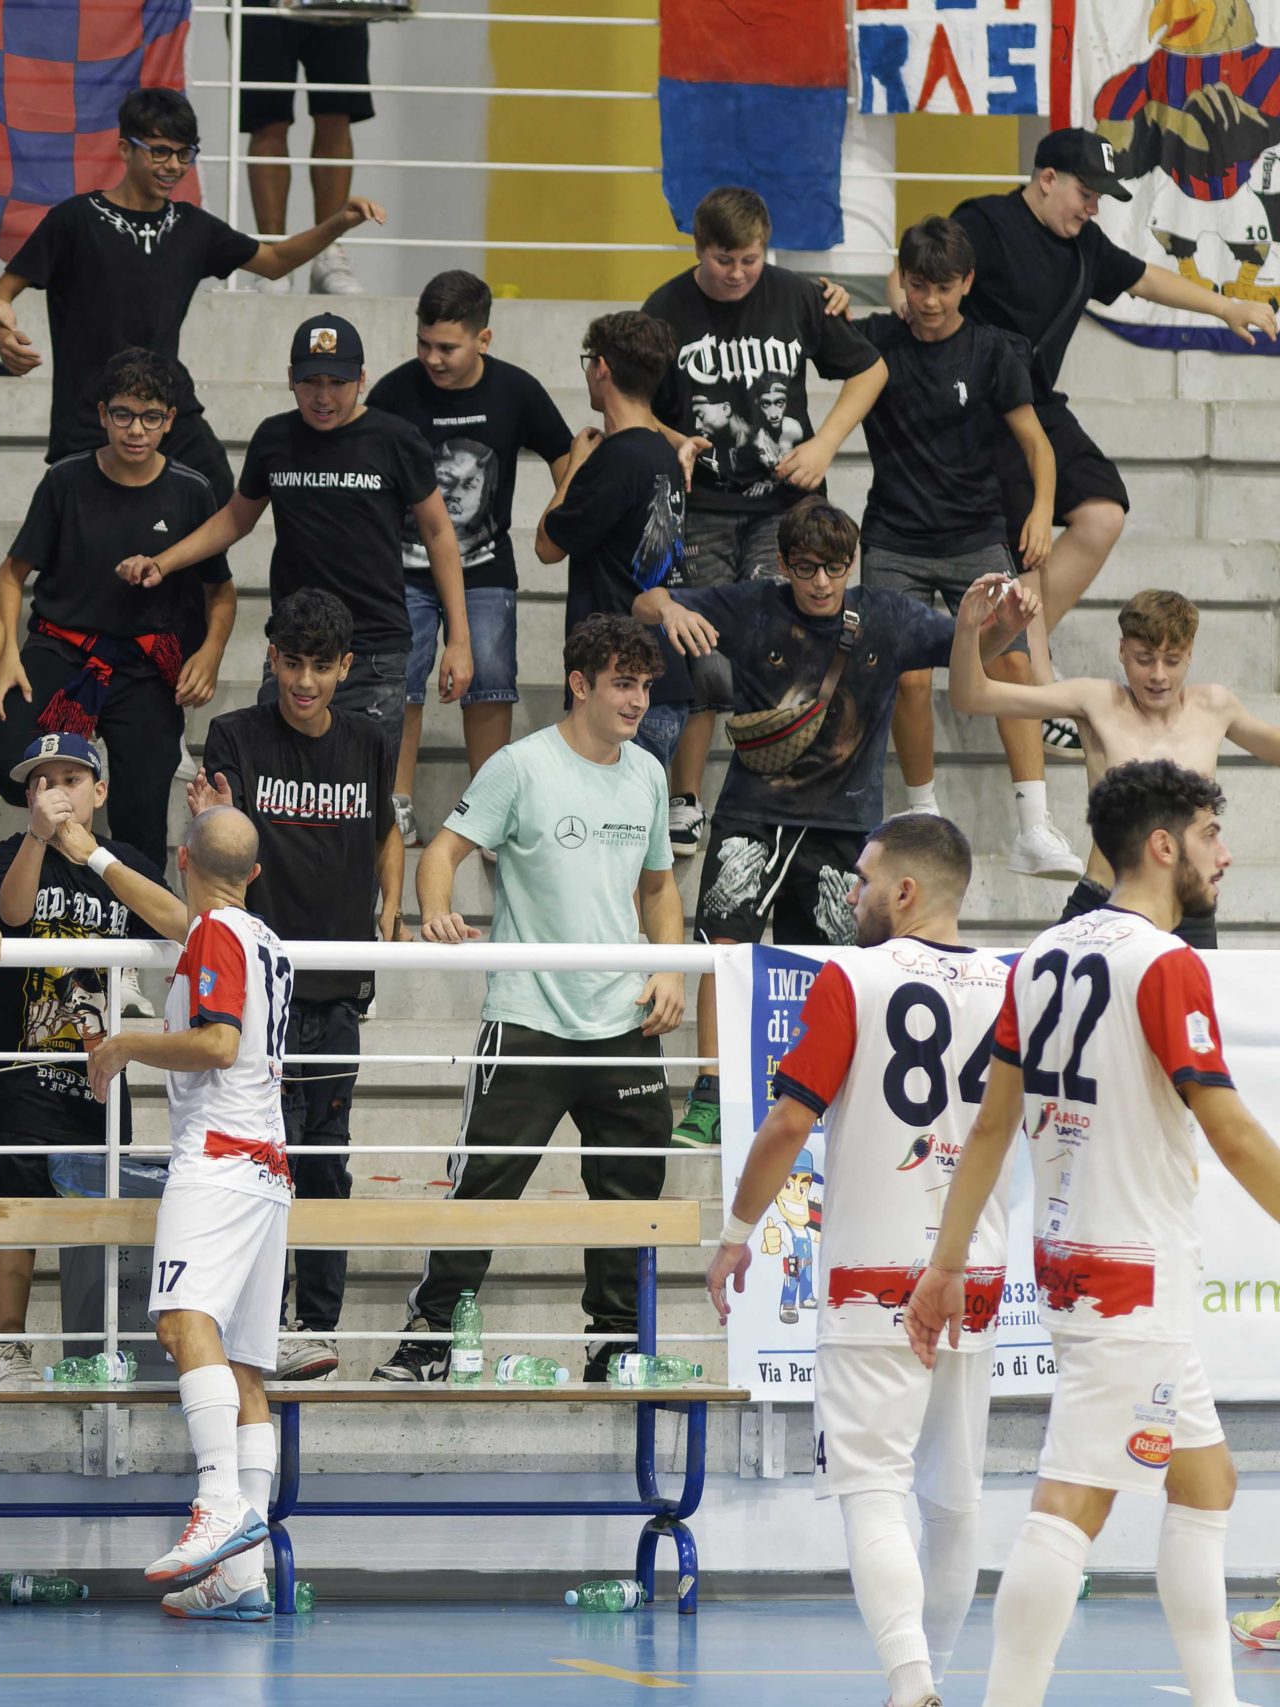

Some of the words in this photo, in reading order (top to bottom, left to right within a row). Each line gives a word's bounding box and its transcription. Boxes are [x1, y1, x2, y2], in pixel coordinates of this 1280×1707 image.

[1245, 226, 1268, 241] 10
[269, 472, 302, 487] CALVIN
[303, 472, 339, 488] KLEIN
[340, 472, 382, 490] JEANS
[256, 775, 367, 819] HOODRICH
[592, 830, 647, 841] PETRONAS
[767, 1009, 789, 1043] di
[1023, 948, 1111, 1105] 22
[617, 1086, 641, 1100] Palm
[158, 1260, 187, 1293] 17
[758, 1362, 783, 1383] Via
[788, 1362, 816, 1383] Par
[1013, 1355, 1029, 1376] di
[816, 1430, 827, 1474] 4
